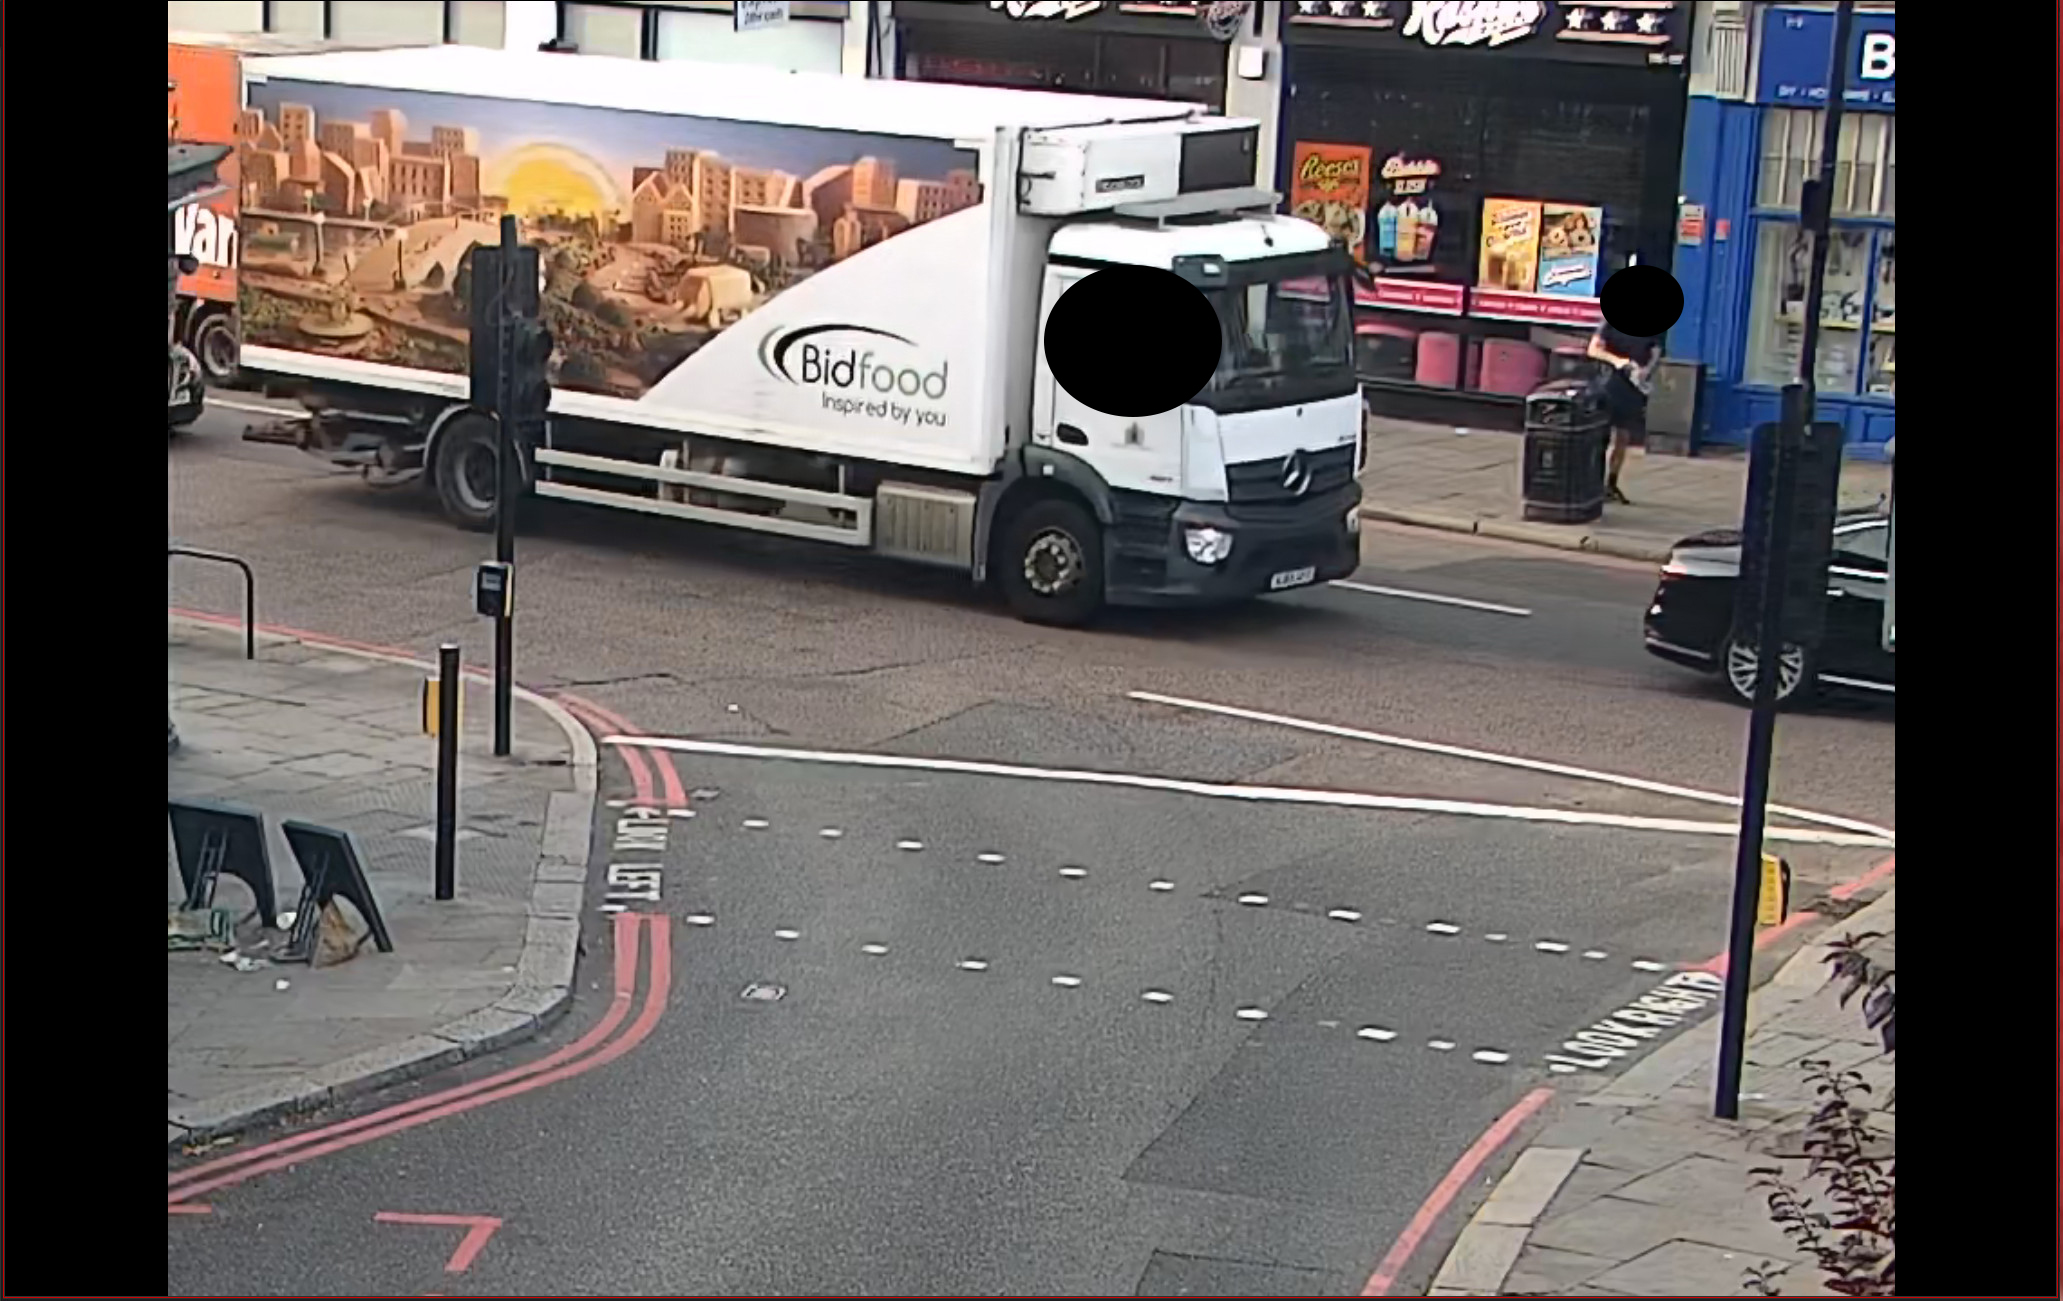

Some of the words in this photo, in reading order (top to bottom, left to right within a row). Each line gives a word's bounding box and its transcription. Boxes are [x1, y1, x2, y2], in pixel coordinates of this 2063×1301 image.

[801, 343, 948, 399] Bidfood
[822, 391, 888, 417] Inspired
[890, 401, 911, 424] by
[915, 407, 946, 426] you
[605, 864, 663, 900] LEFT
[1544, 1018, 1663, 1068] LOOK
